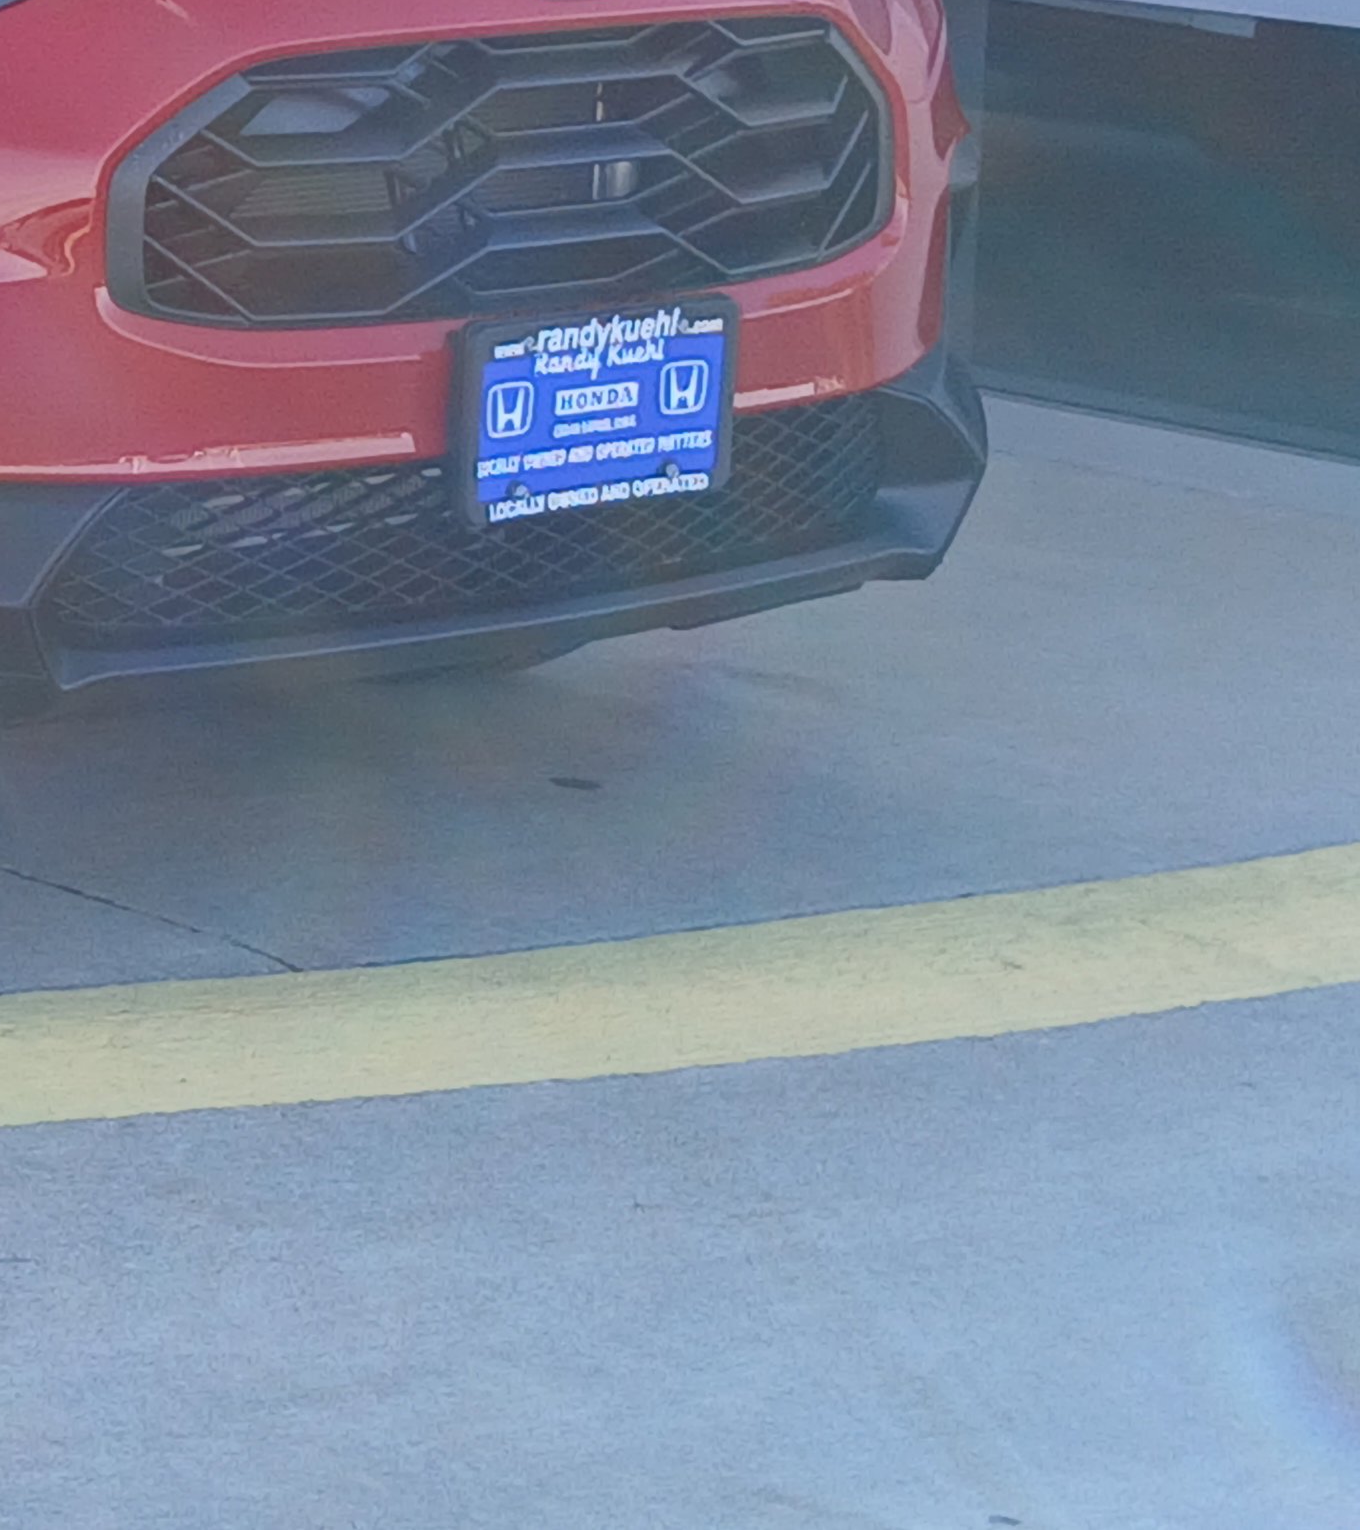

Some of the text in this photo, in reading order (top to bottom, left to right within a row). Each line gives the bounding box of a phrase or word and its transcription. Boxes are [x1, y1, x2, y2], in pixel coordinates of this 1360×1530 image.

[534, 339, 665, 381] Randy Kuehl
[560, 386, 634, 411] HONDA
[489, 494, 546, 523] LOCALLY
